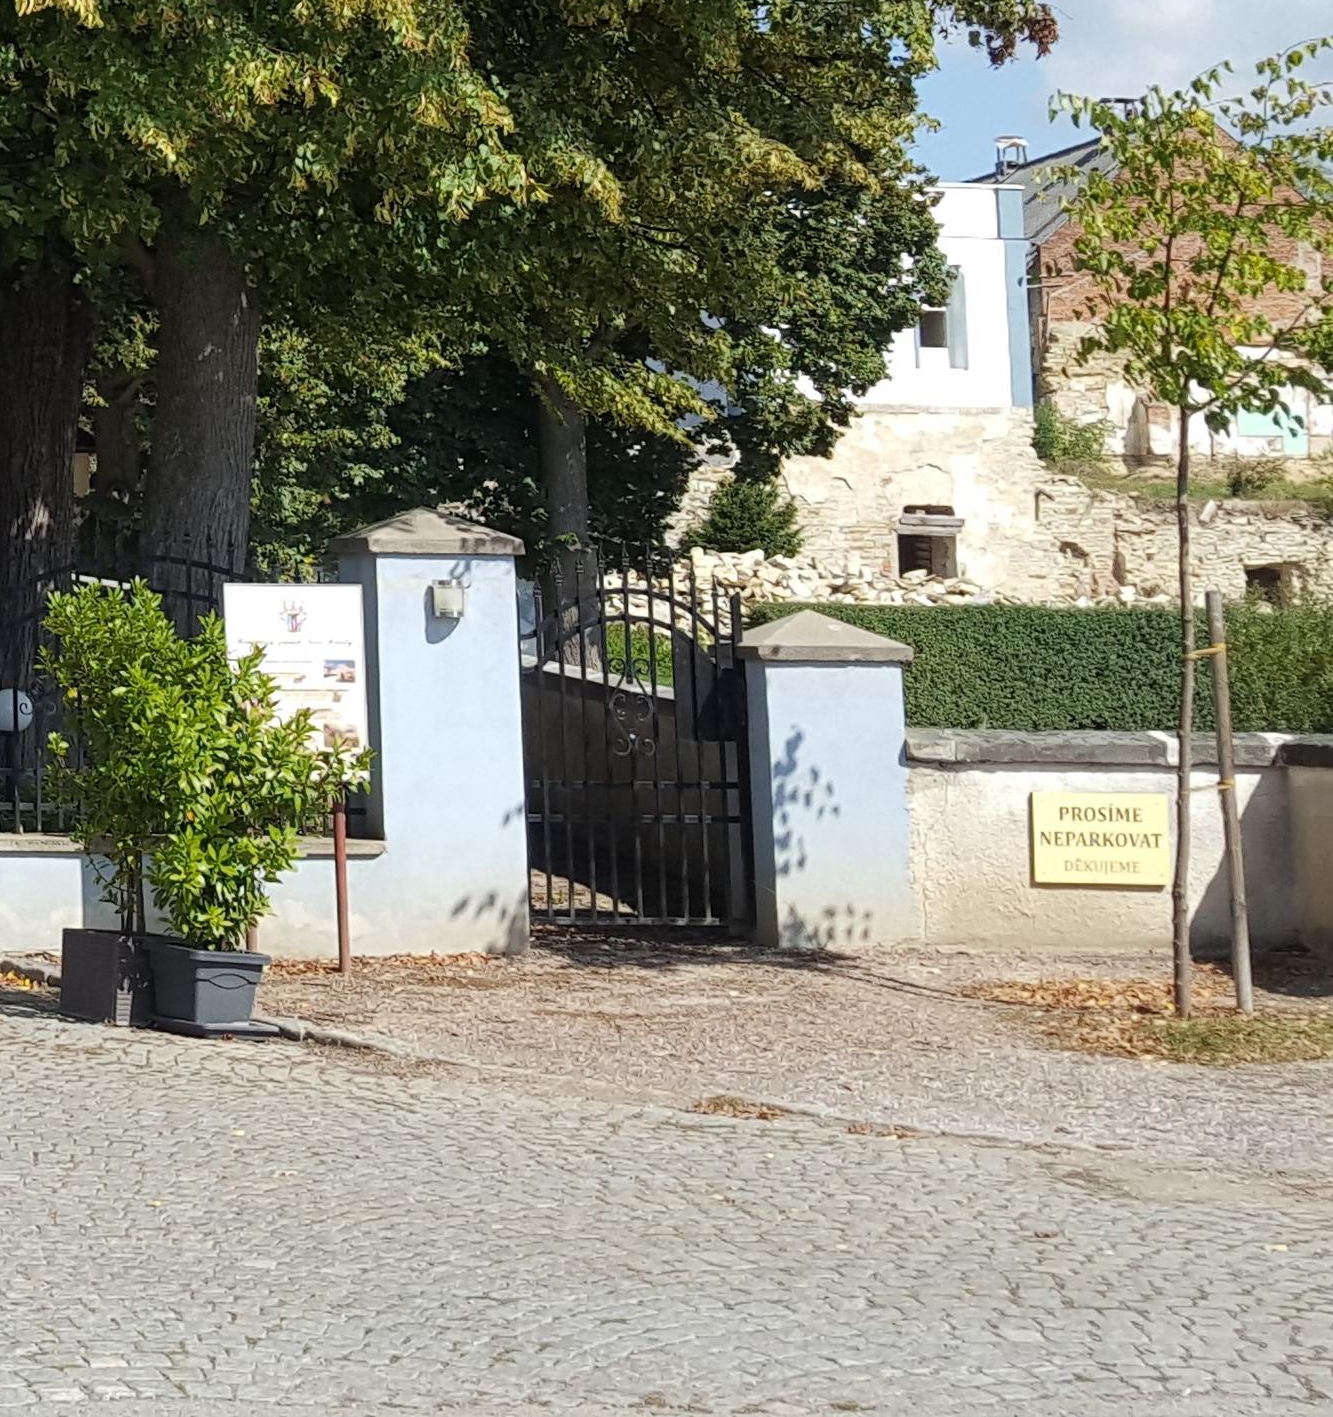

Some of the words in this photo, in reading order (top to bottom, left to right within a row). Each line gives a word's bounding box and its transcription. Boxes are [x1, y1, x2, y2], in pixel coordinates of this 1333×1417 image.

[1058, 803, 1144, 823] PROSÍME
[1039, 831, 1163, 849] NEPARKOVAT
[1063, 858, 1141, 875] DĚKUJEME
